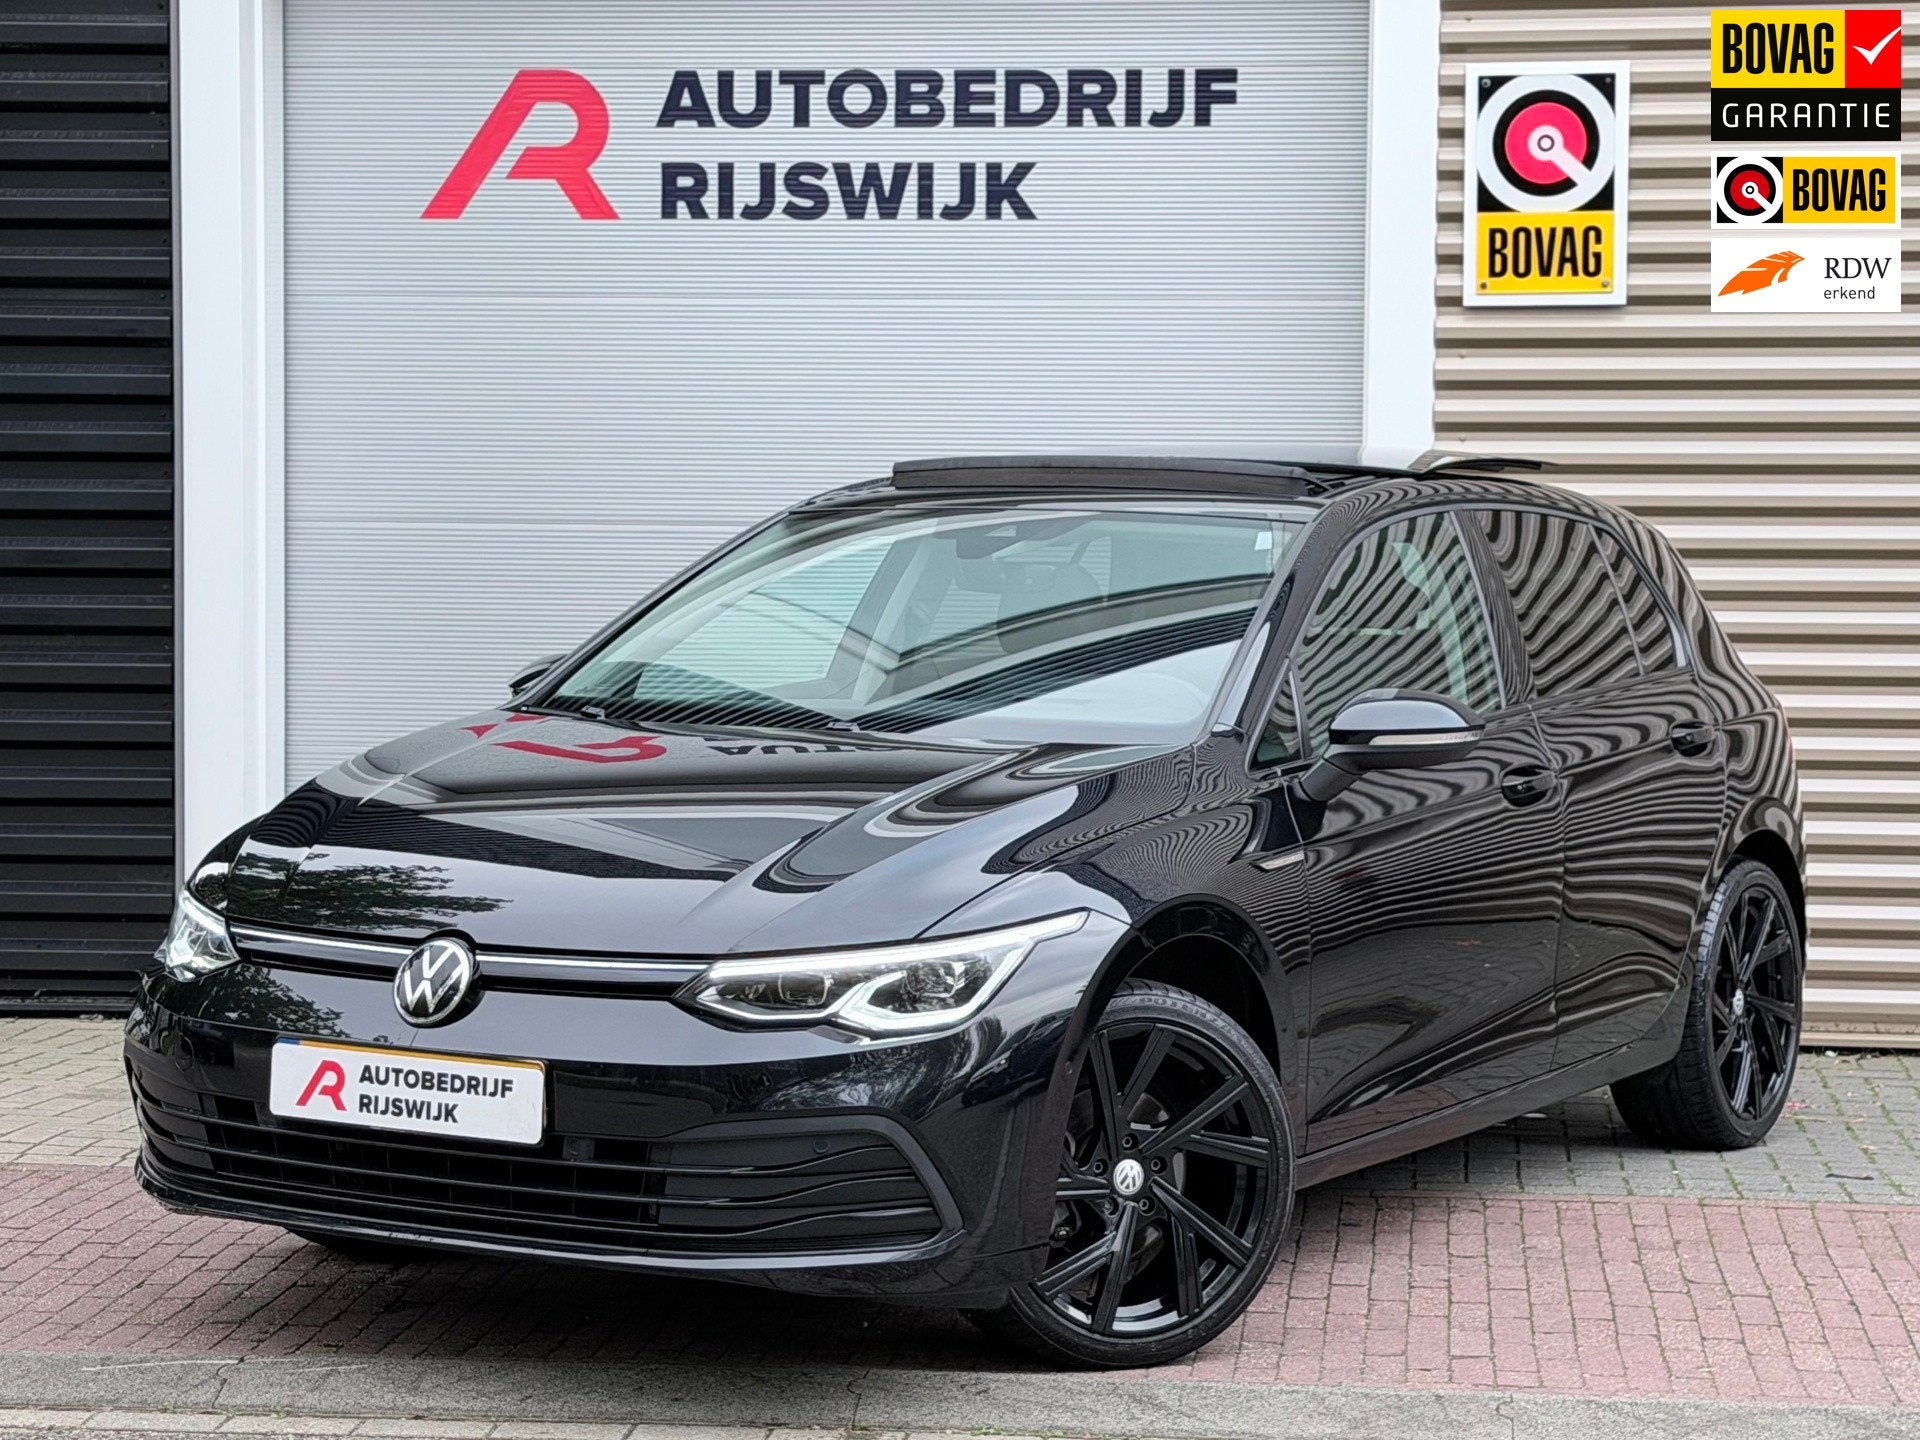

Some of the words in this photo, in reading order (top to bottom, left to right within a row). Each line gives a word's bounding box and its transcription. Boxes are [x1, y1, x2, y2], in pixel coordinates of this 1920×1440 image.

[657, 68, 1239, 128] AUTOBEDRIJF
[661, 161, 1037, 221] RIJSWIJK
[1488, 225, 1603, 279] BOVAG
[358, 1093, 459, 1123] RIJSWIJK
[359, 1064, 514, 1098] AUTOBEDRIJF
